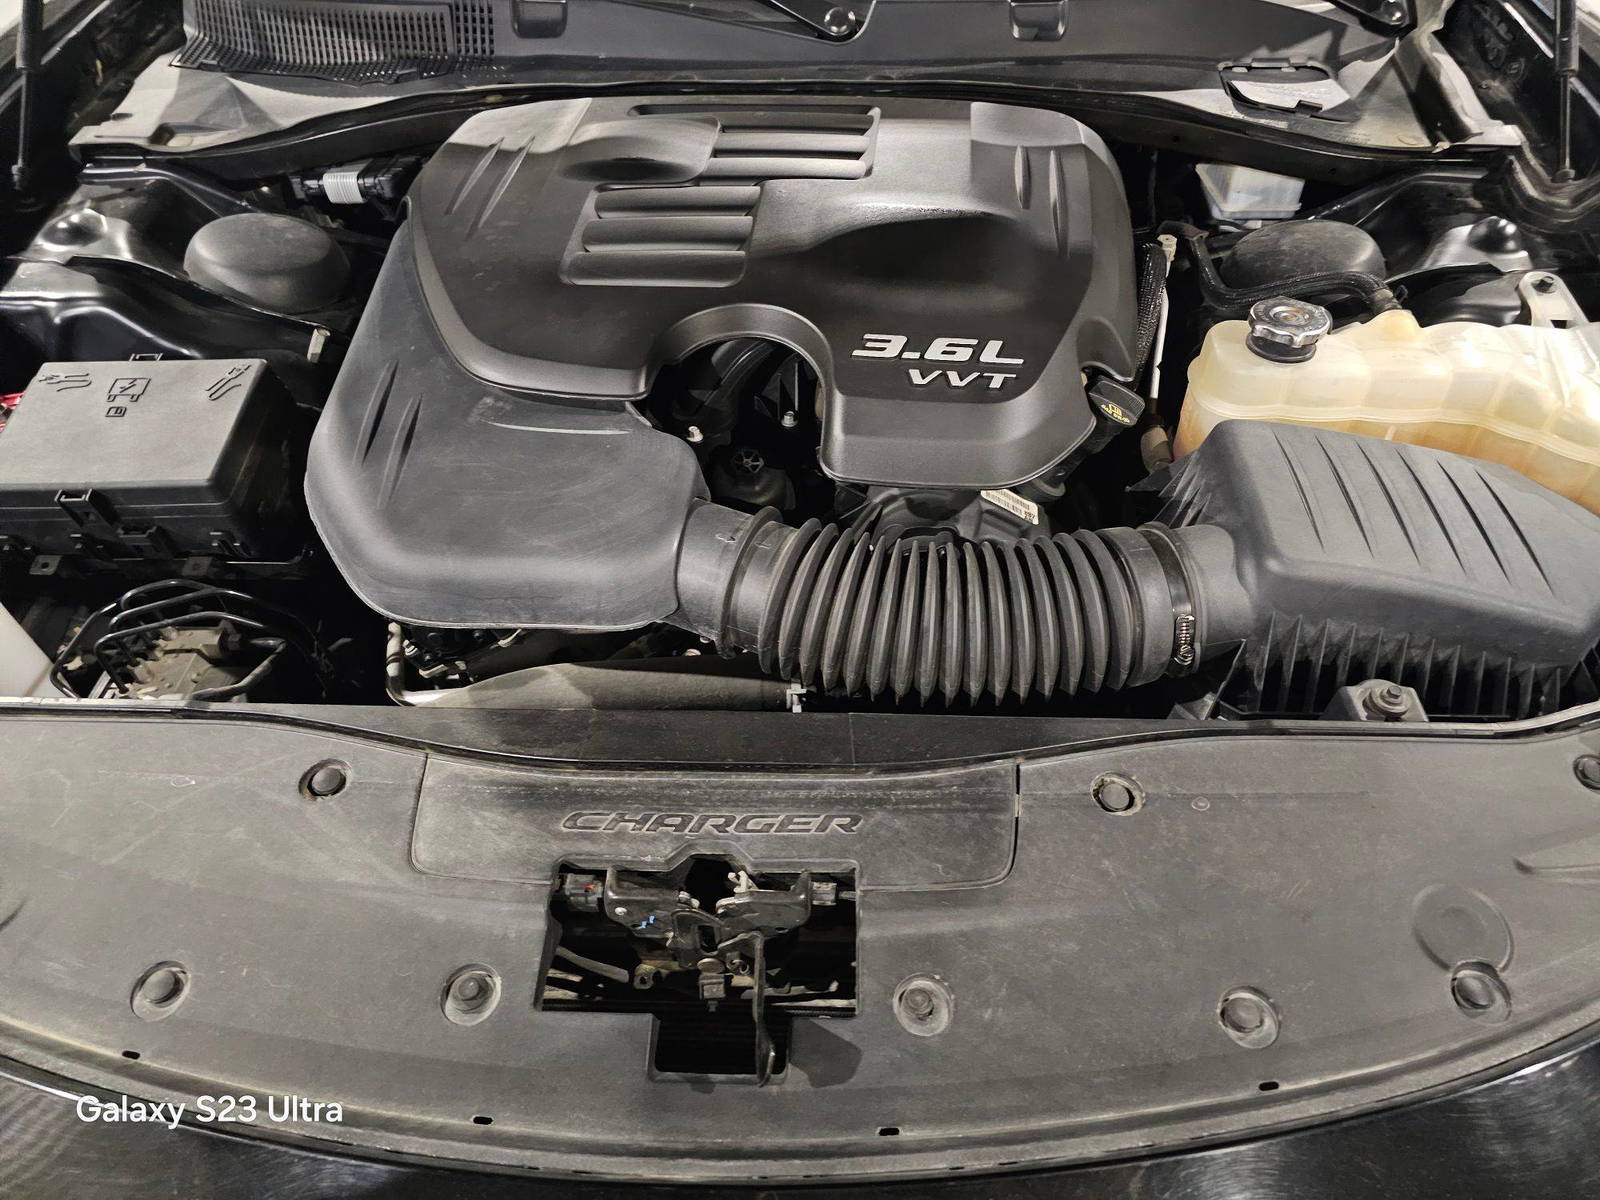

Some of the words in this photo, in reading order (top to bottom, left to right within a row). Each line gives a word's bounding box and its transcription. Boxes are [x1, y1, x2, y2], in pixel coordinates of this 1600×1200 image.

[852, 333, 1024, 364] 3.6L
[908, 368, 1017, 389] VVT
[562, 811, 863, 834] CHARGER
